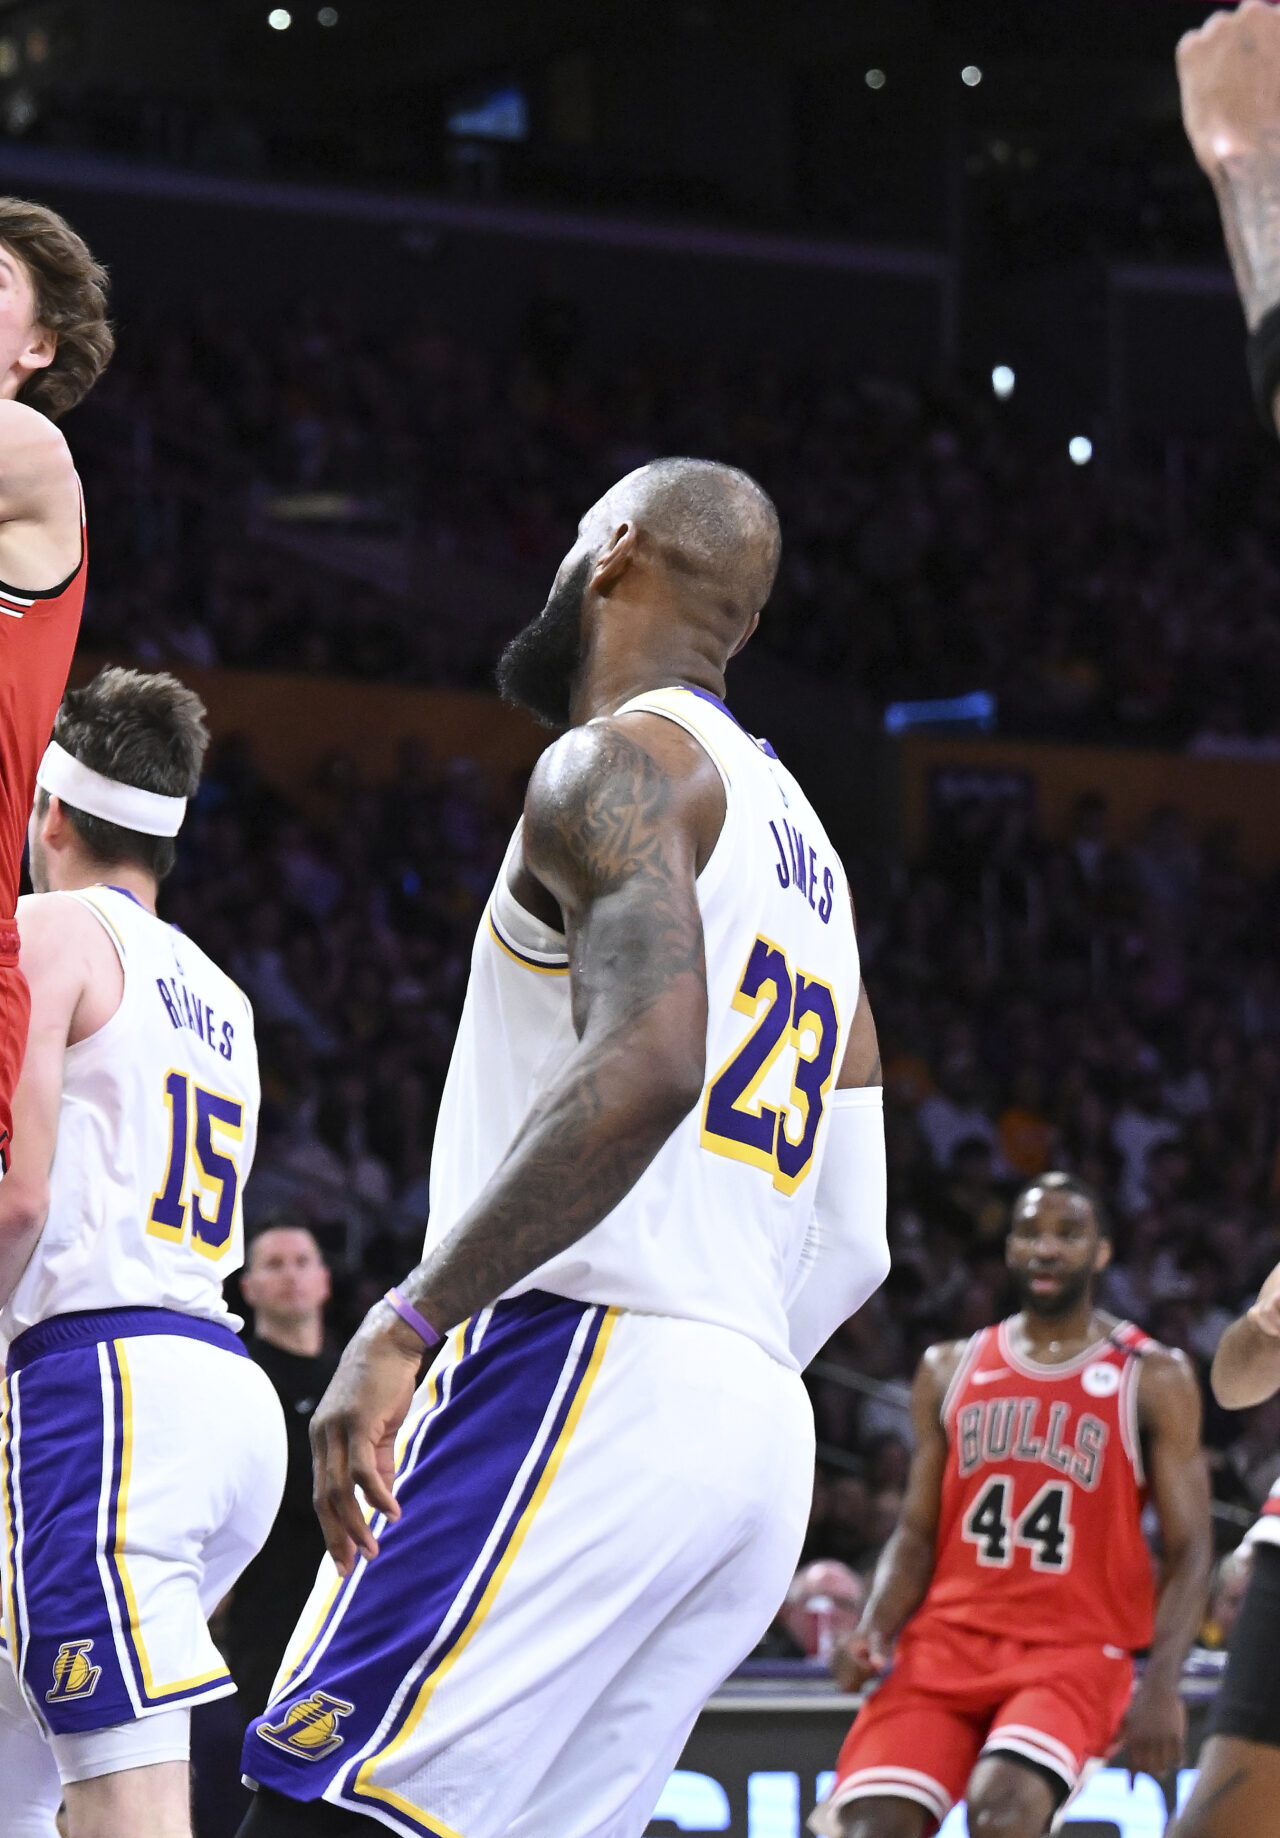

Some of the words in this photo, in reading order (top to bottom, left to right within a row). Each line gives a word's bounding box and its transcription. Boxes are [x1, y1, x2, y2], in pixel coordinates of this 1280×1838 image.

[768, 818, 834, 925] JAMES
[156, 977, 234, 1061] REAVES
[699, 932, 841, 1197] 23
[146, 1068, 244, 1262] 15
[958, 1397, 1108, 1491] BULLS
[961, 1473, 1074, 1575] 44
